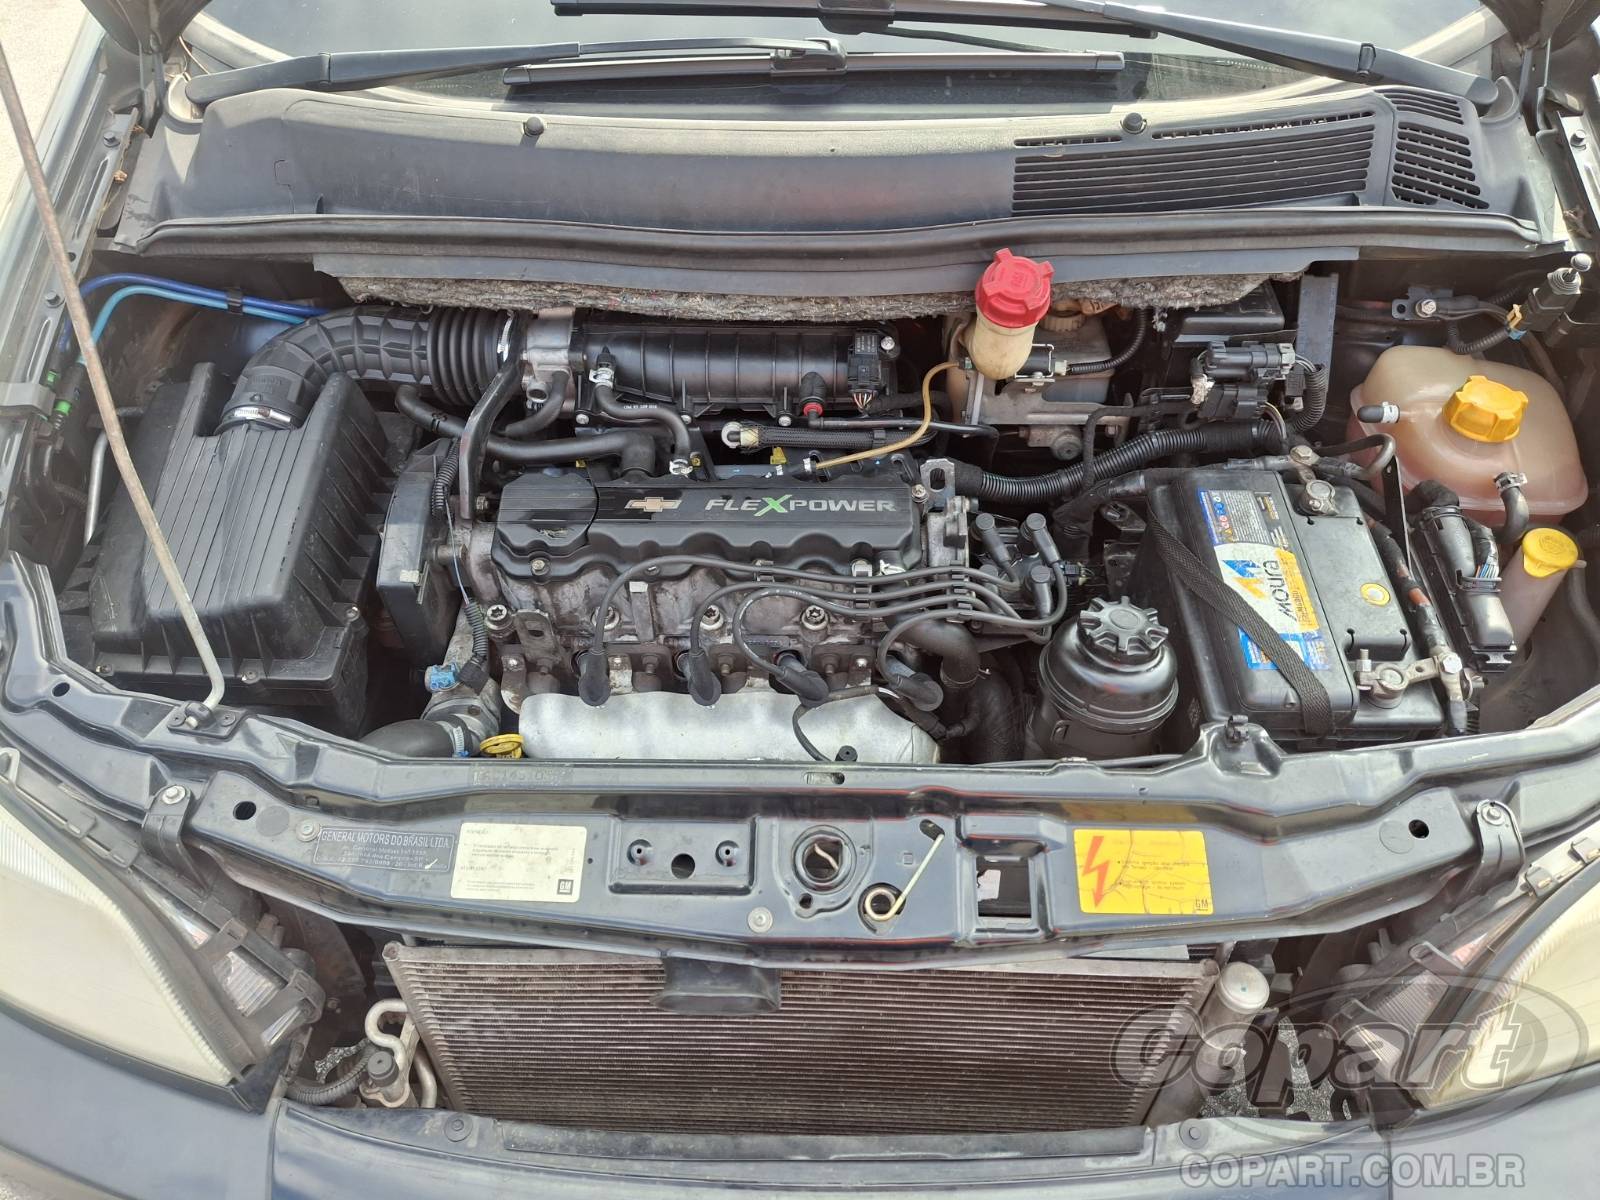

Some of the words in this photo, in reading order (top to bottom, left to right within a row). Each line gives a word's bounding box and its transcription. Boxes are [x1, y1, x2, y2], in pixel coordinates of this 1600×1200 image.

[704, 494, 897, 517] FLEXPOWER
[321, 830, 355, 842] GENERAL
[357, 832, 390, 845] MOTORS
[390, 835, 402, 846] DO
[402, 835, 429, 847] BRASIL
[559, 880, 572, 892] GM
[1195, 898, 1209, 908] GM
